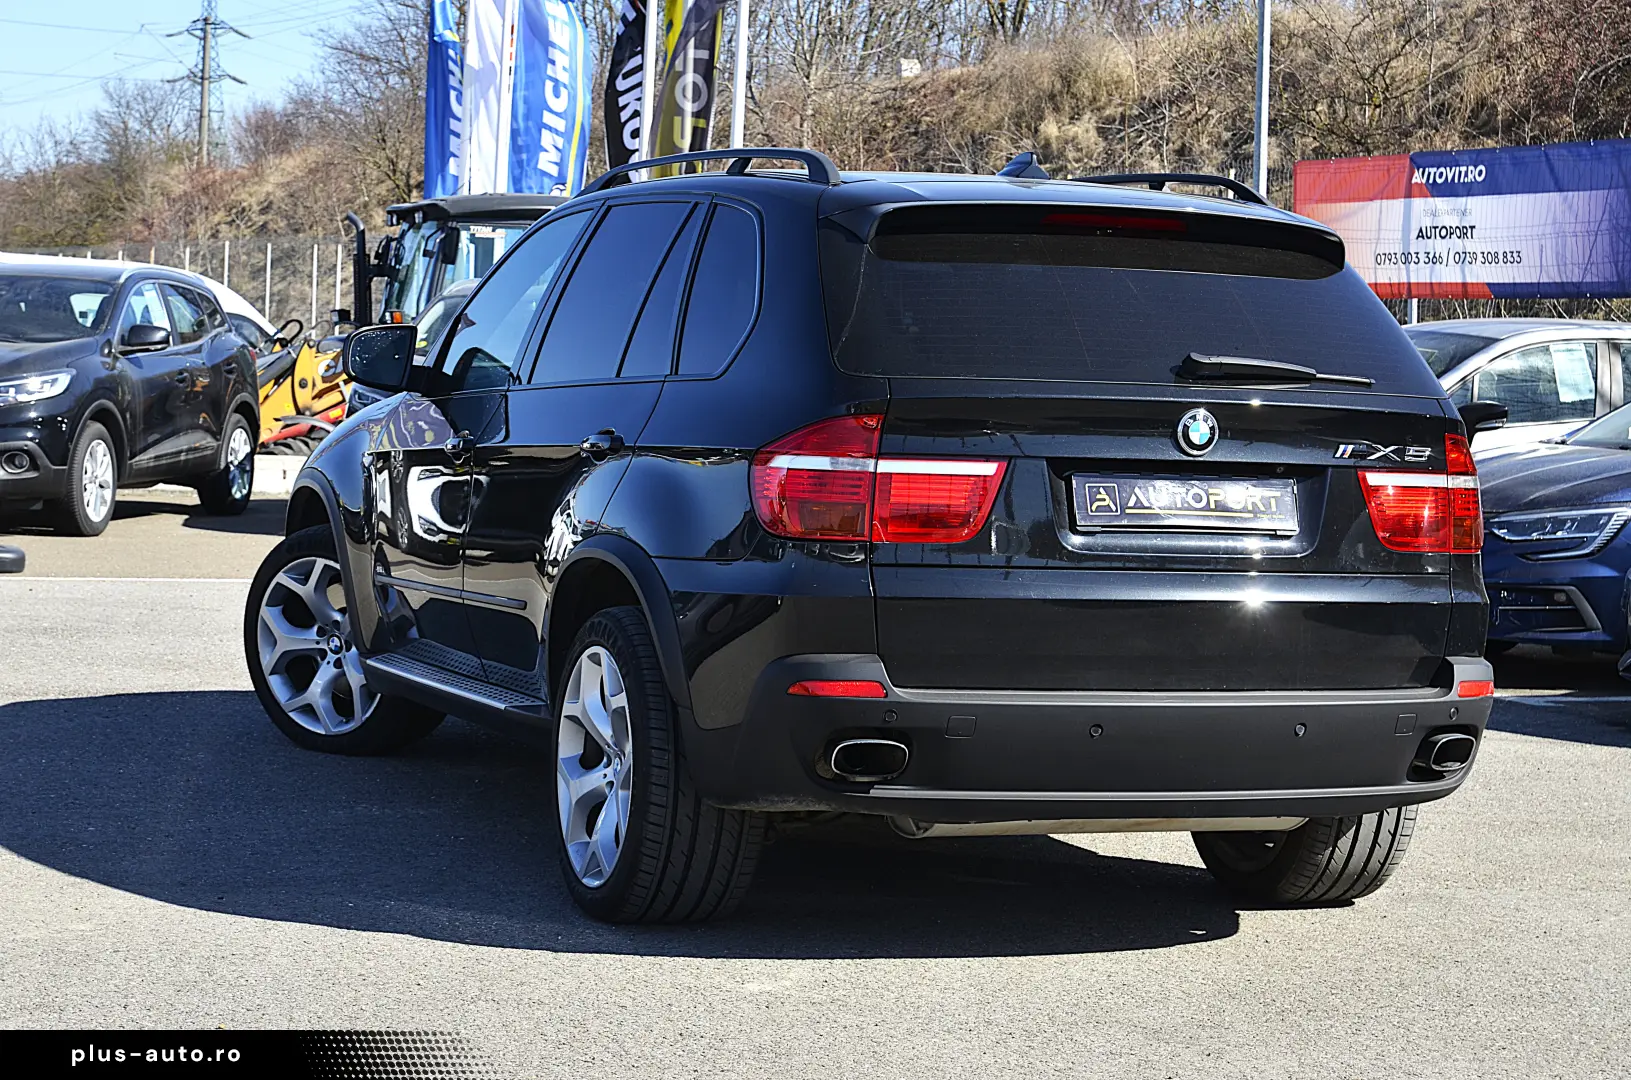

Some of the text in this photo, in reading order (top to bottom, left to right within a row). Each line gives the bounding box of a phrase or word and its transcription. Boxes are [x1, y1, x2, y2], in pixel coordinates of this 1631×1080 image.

[1411, 164, 1486, 184] AUTOVIT.RO
[1416, 225, 1476, 240] AUTOPORT
[1375, 252, 1398, 265] 0793
[1400, 252, 1420, 265] 003
[1423, 251, 1443, 265] 366
[1453, 251, 1477, 265] 0739
[1480, 251, 1499, 264] 308
[1502, 250, 1522, 264] 833
[1127, 485, 1282, 512] AUTOPORT
